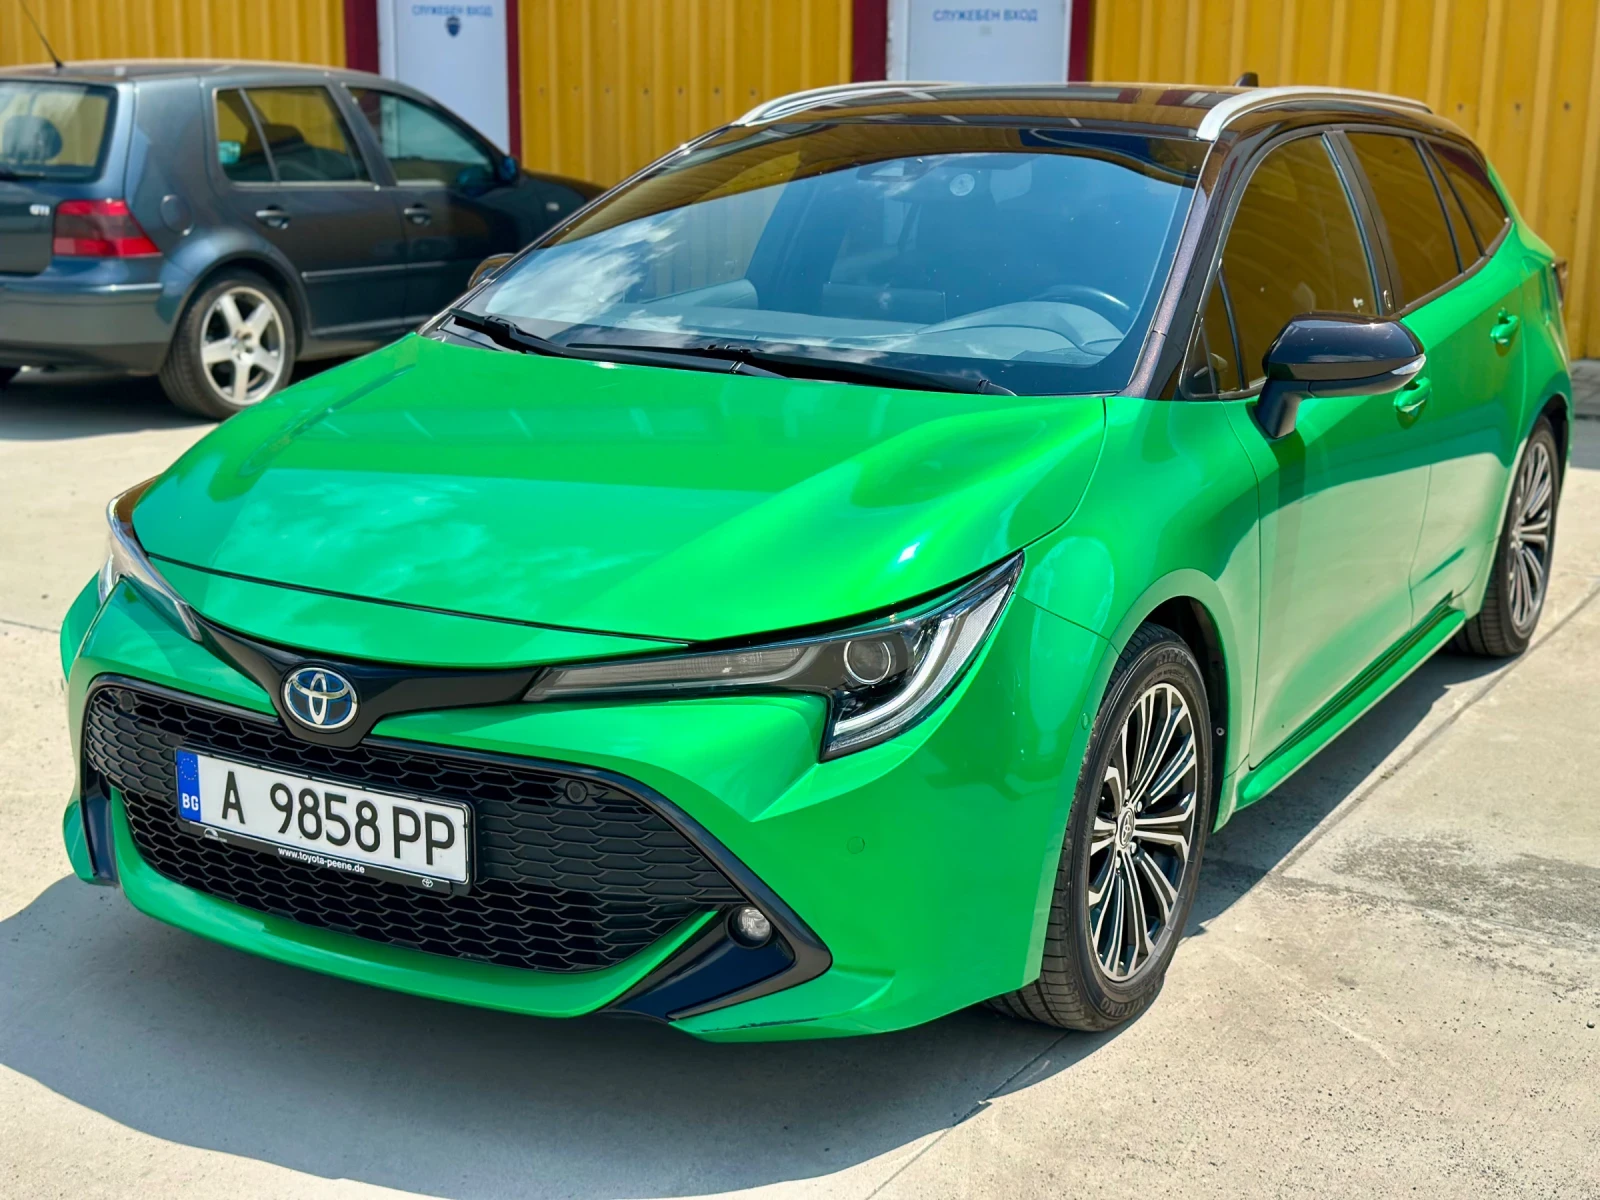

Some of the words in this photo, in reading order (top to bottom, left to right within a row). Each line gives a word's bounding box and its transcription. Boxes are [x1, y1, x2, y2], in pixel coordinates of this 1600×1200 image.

[932, 9, 1000, 21] СЛУЖЕБЕН
[1003, 9, 1038, 22] ВХОД
[182, 792, 199, 811] BG
[221, 770, 246, 825] A
[269, 782, 381, 853] 9858
[392, 805, 456, 866] PP
[277, 847, 365, 874] www.toyota-peene.de
